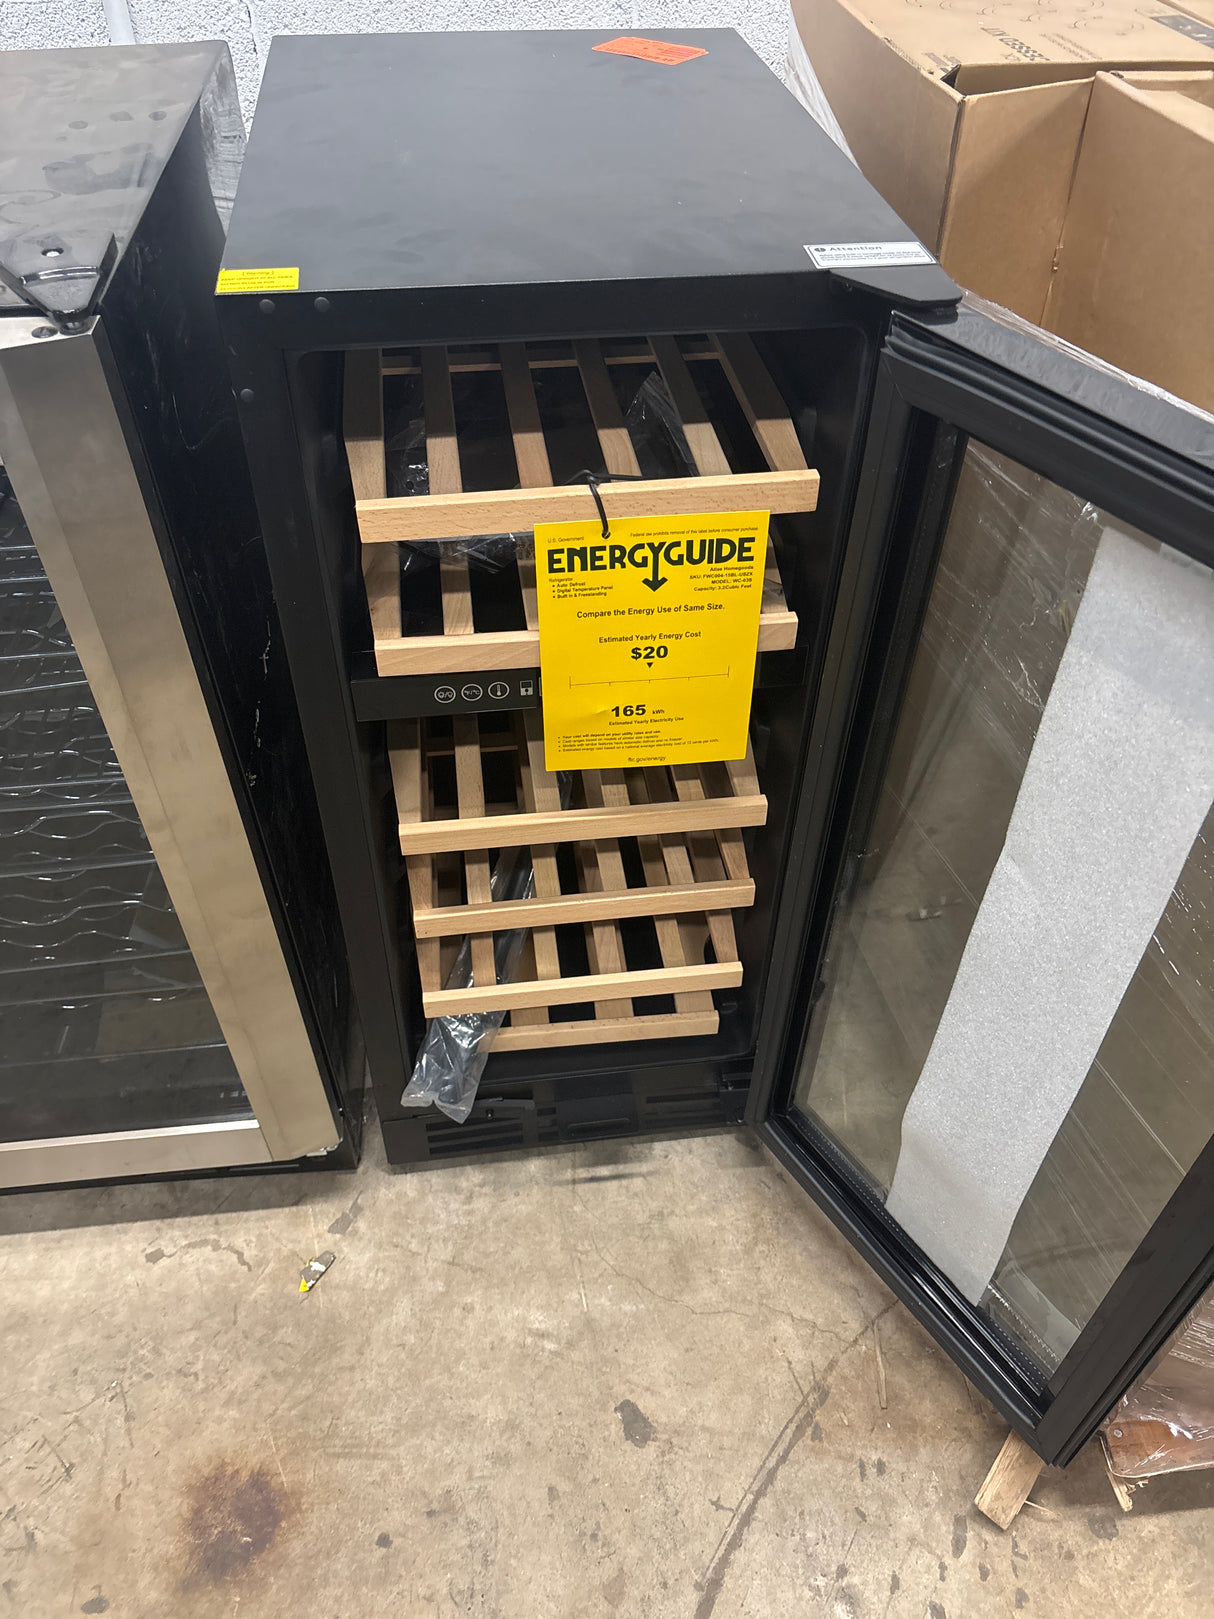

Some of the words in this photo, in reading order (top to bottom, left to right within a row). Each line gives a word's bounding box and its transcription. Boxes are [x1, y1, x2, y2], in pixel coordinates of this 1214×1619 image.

[547, 537, 755, 577] ENERGYGUIDE
[576, 610, 612, 619] Compare
[627, 607, 655, 616] Energy
[657, 606, 672, 614] Use
[683, 604, 705, 612] Same
[706, 602, 725, 610] Size.
[598, 635, 634, 643] Estimated
[635, 633, 657, 642] Yearly
[658, 632, 683, 640] Energy
[630, 645, 669, 660] $20
[611, 704, 646, 717] 165
